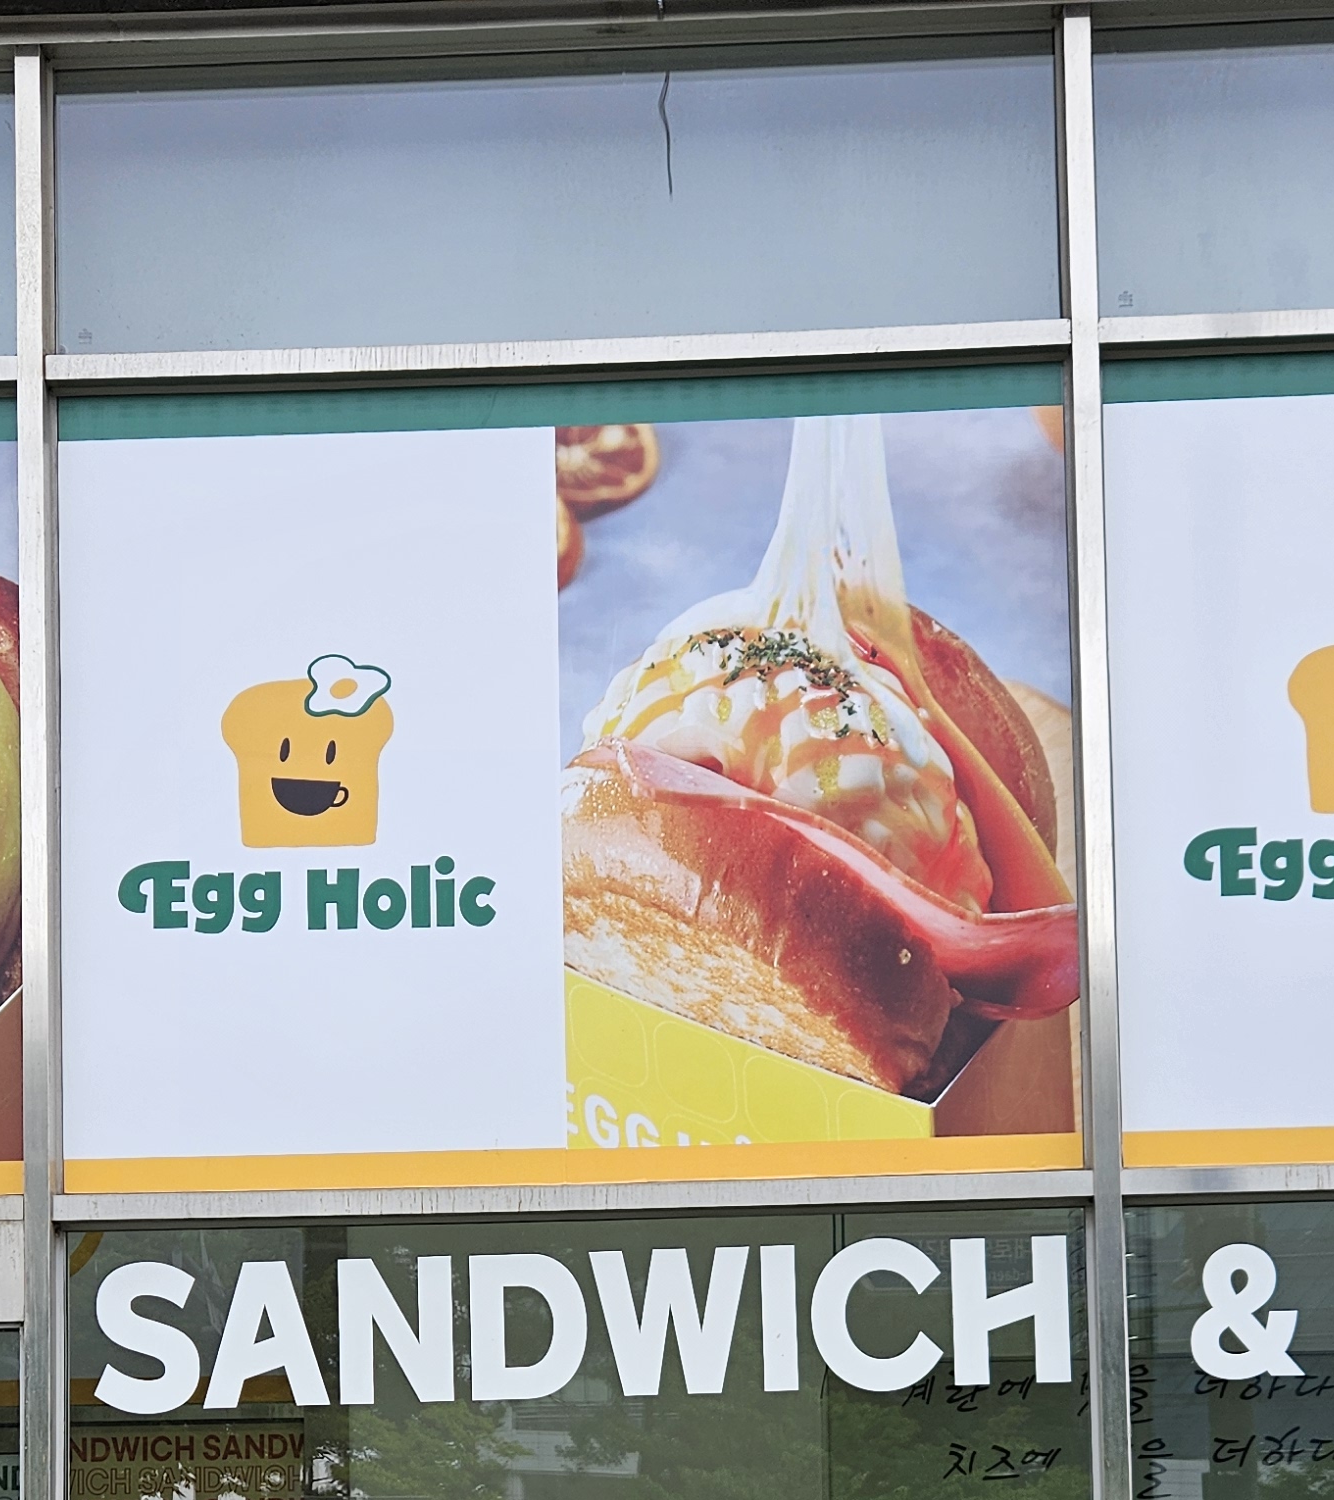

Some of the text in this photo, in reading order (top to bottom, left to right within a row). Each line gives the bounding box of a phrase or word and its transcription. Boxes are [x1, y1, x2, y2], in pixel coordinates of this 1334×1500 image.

[118, 856, 497, 933] Egg Holic
[94, 1234, 1072, 1414] SANDWICH
[1191, 1243, 1306, 1380] &
[943, 1443, 1062, 1481] 치즈에
[1133, 1438, 1174, 1500] 을
